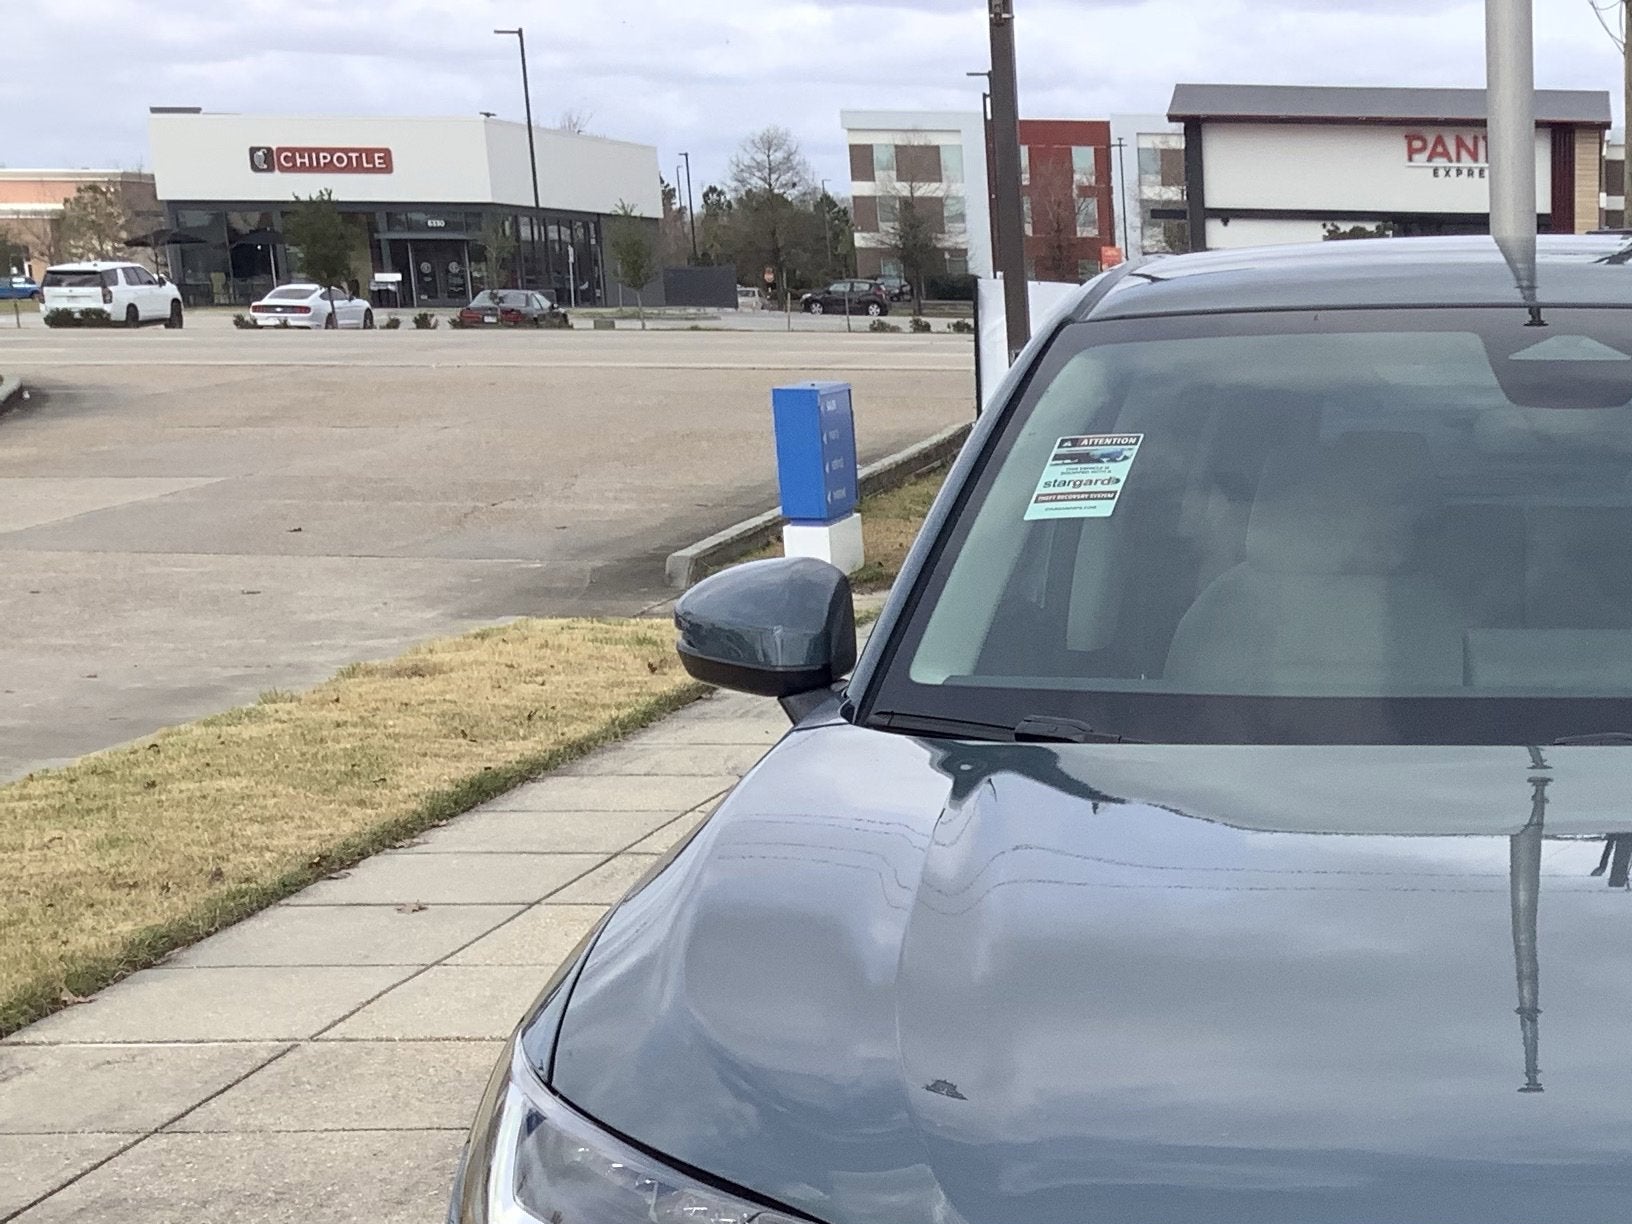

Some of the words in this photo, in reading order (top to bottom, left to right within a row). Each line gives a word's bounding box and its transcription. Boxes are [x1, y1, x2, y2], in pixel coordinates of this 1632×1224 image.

[280, 152, 386, 168] CHIPOTLE
[1433, 168, 1486, 179] EXPRE
[1080, 437, 1137, 446] ATTENTION
[1042, 476, 1113, 489] stargard
